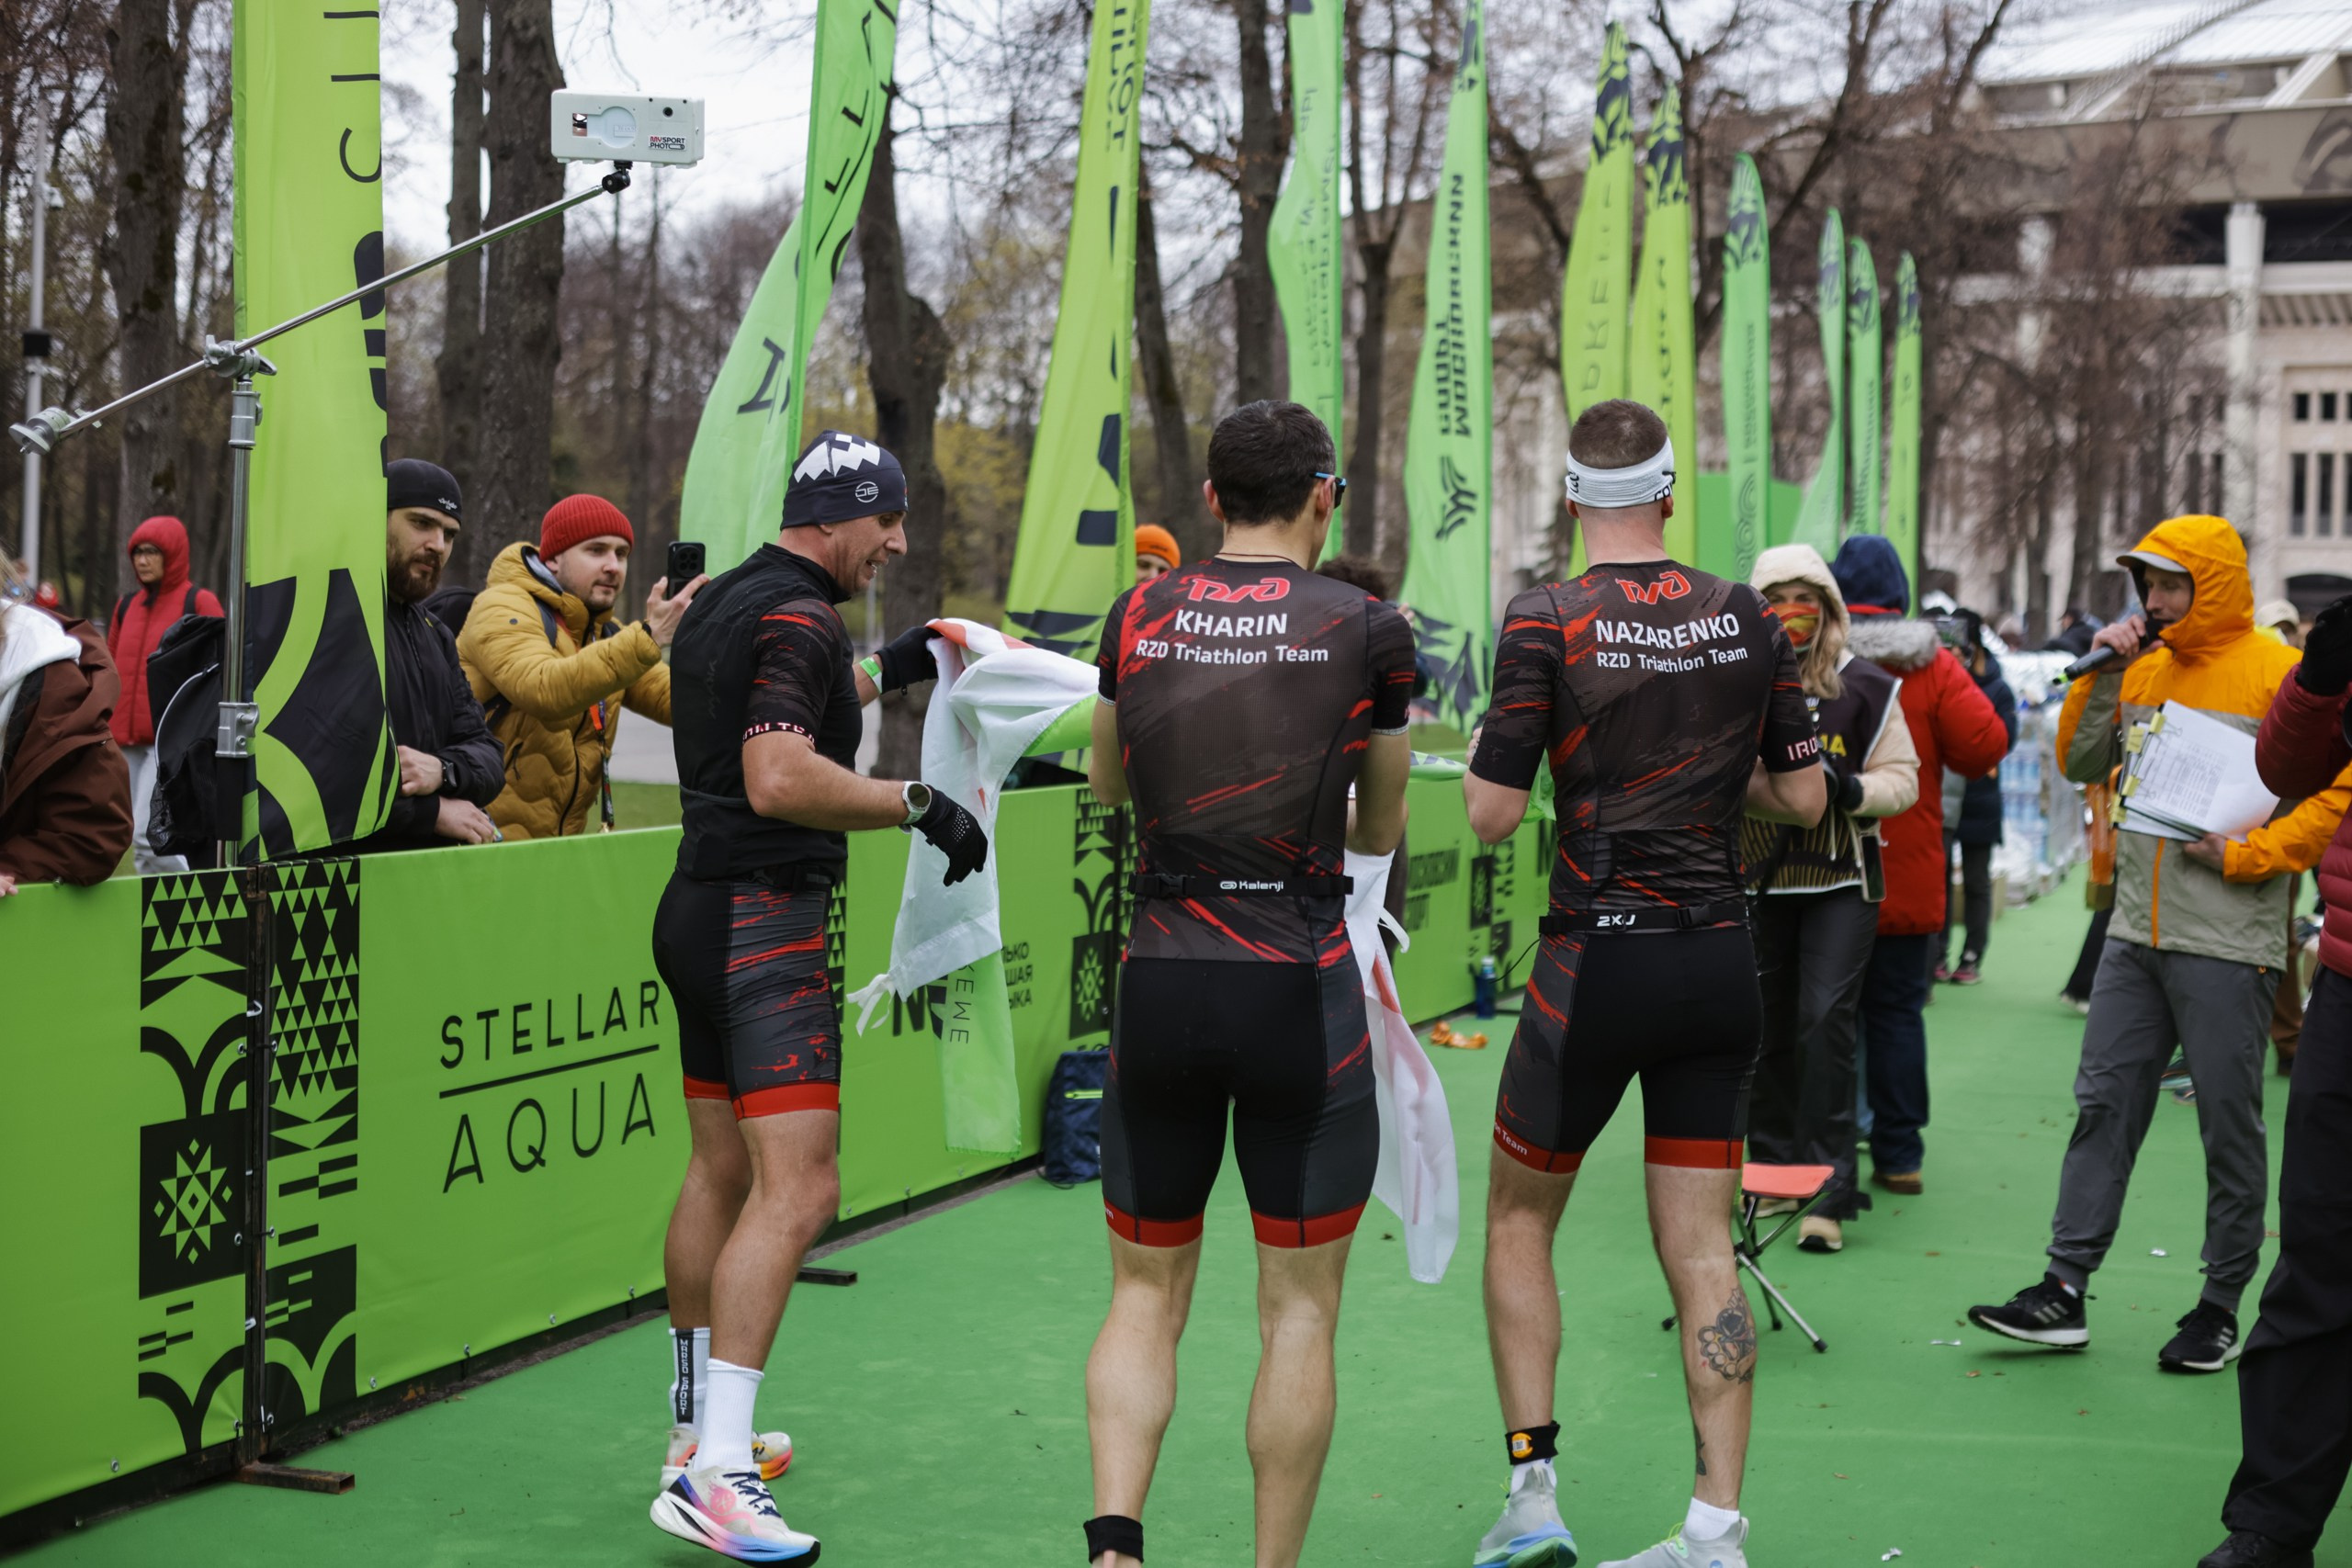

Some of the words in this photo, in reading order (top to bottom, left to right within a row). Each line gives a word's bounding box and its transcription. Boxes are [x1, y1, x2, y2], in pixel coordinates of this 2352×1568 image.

[1174, 609, 1287, 637] KHARIN
[1595, 613, 1740, 649] NAZARENKO
[1136, 638, 1169, 659] RZD
[1174, 643, 1267, 664] Triathlon
[1275, 645, 1329, 662] Team
[1597, 651, 1631, 669] RZD
[1637, 653, 1704, 673] Triathlon
[1708, 647, 1748, 665] Team
[1238, 880, 1284, 892] Kalenji
[440, 979, 661, 1069] STELLAR
[443, 1072, 656, 1194] AQUA
[1502, 1131, 1528, 1156] Team
[680, 1376, 689, 1416] SPORT
